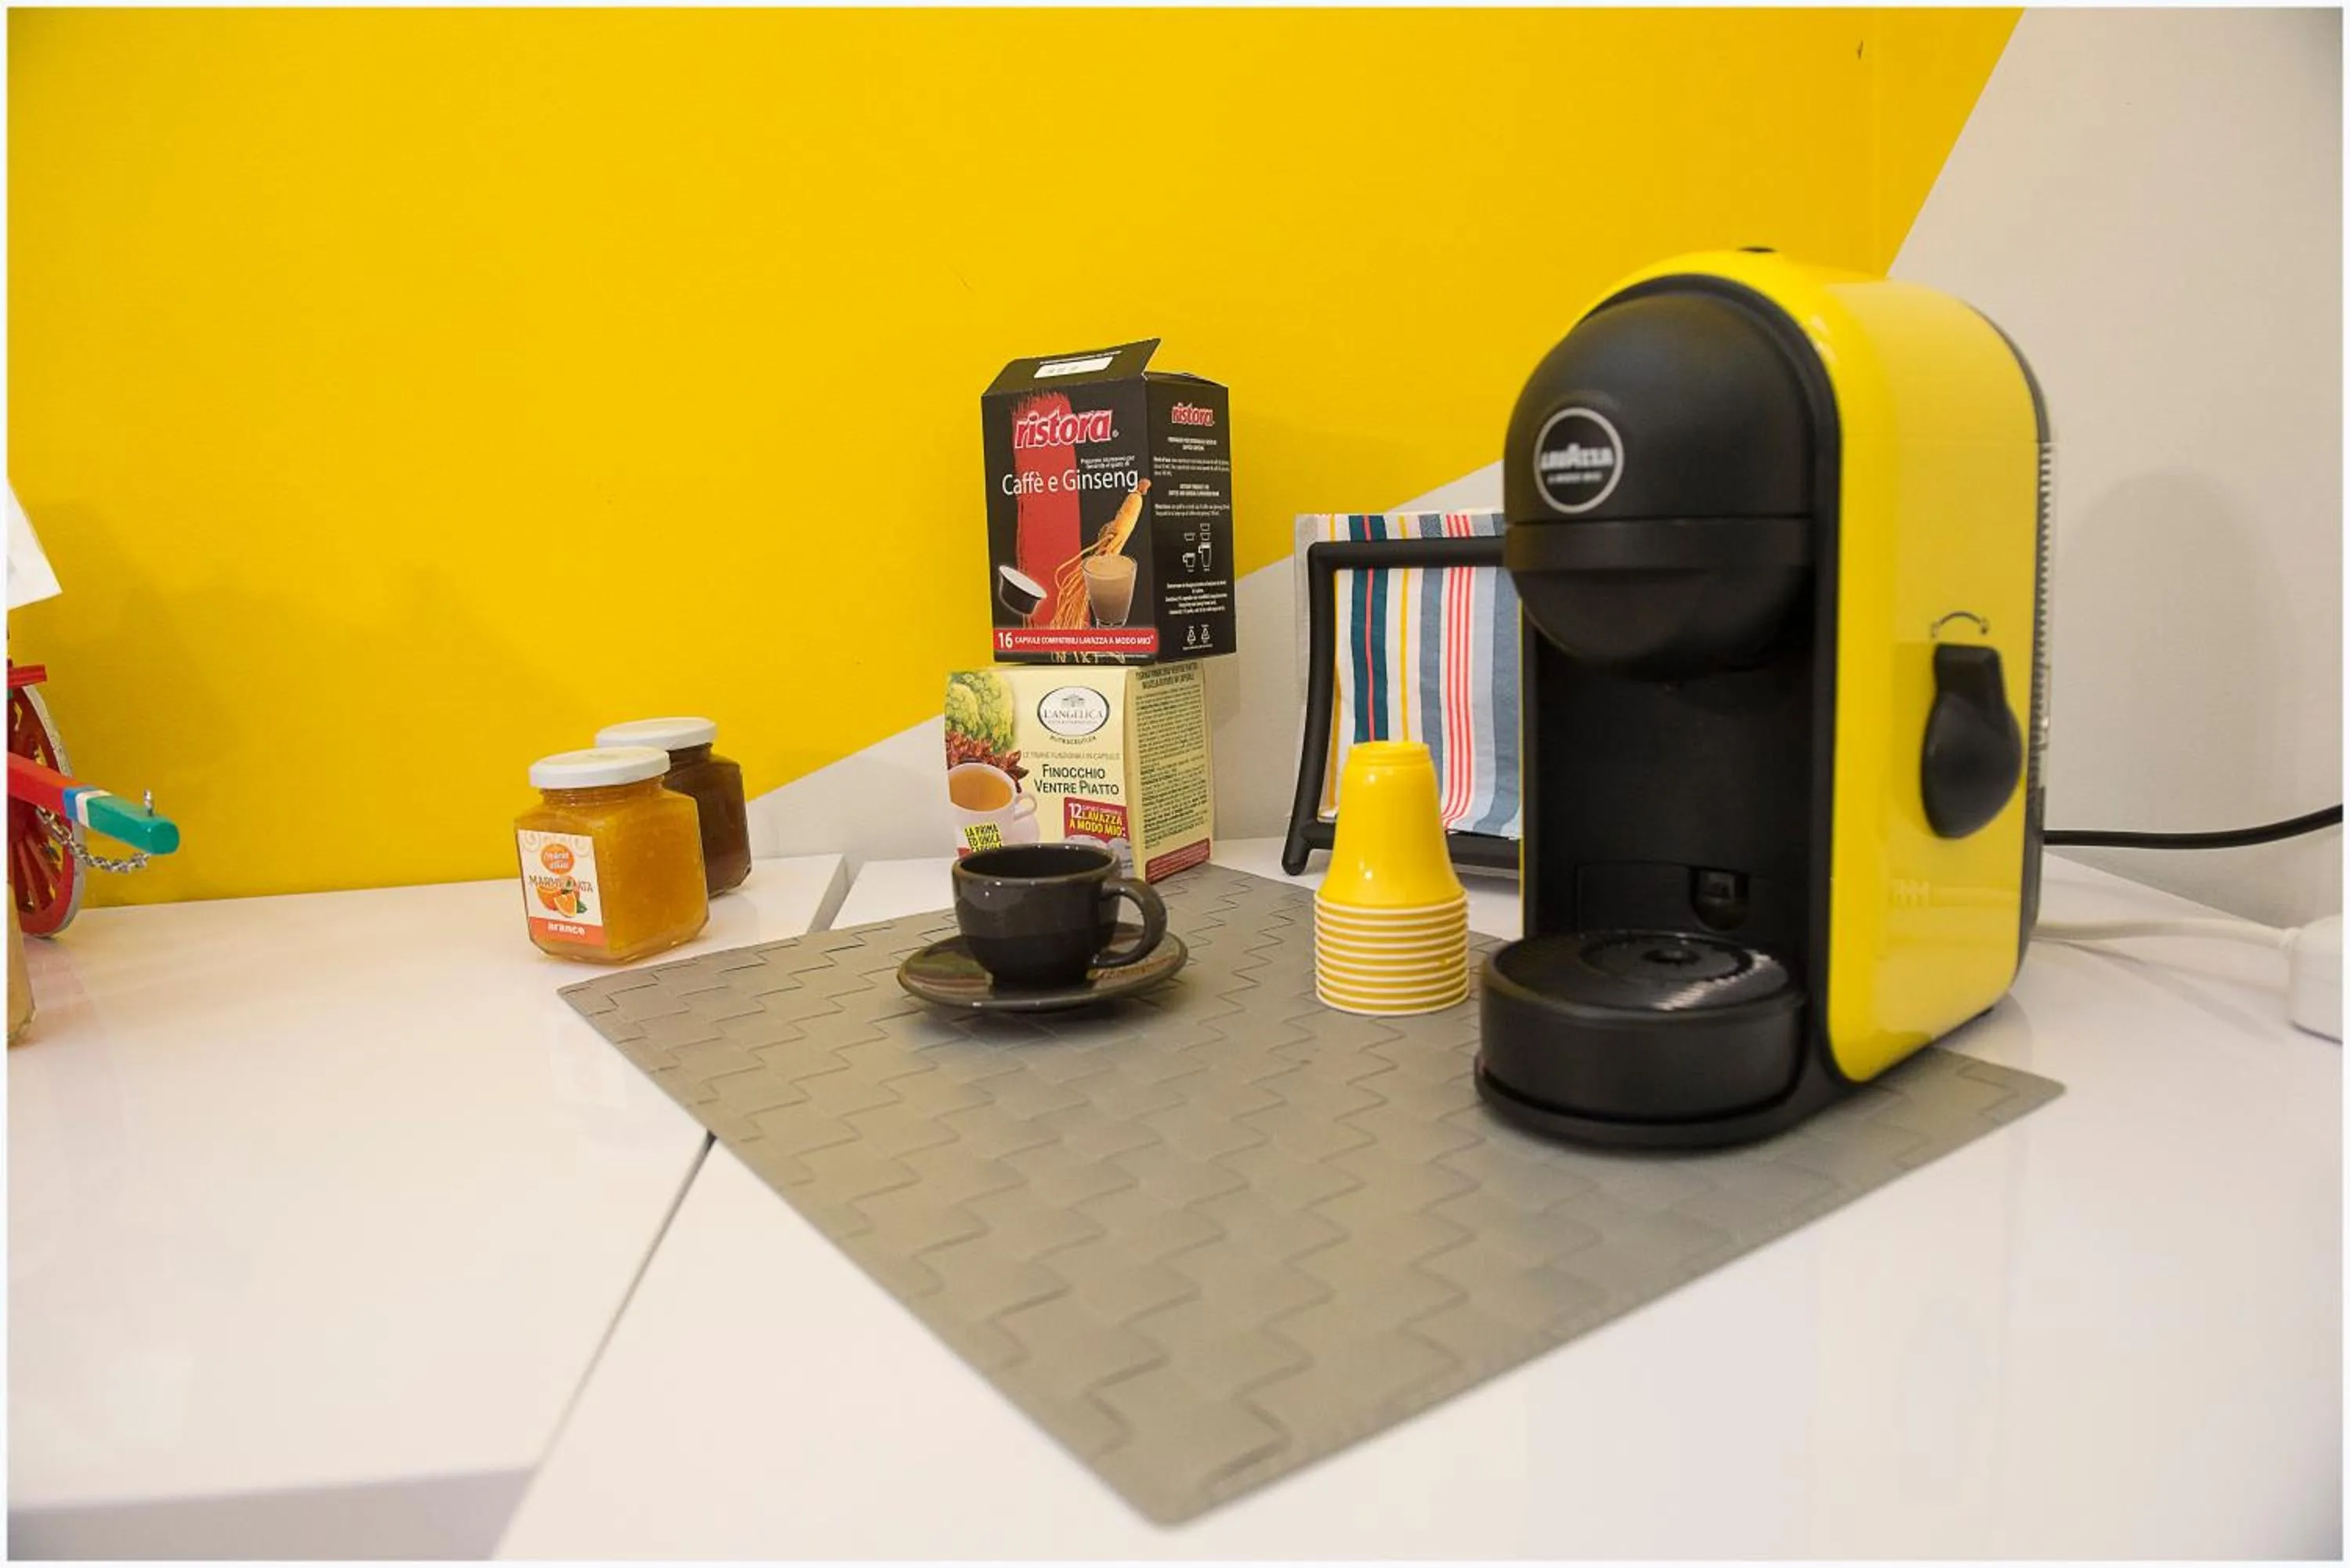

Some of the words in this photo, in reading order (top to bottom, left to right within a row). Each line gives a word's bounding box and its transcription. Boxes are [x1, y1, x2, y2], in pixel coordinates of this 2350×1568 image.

[1172, 402, 1213, 426] ristora
[1014, 405, 1113, 449] ristora
[1002, 470, 1043, 496] Caffè
[1047, 476, 1058, 490] e
[1062, 469, 1138, 493] Ginseng
[998, 632, 1014, 649] 16
[1042, 764, 1106, 779] FINOCCHIO
[1033, 779, 1077, 794] VENTRE
[1079, 780, 1120, 795] PIATTO
[1068, 802, 1082, 819] 12
[1081, 811, 1123, 826] LAVAZZA
[1068, 818, 1076, 829] A
[1077, 819, 1104, 834] MODO
